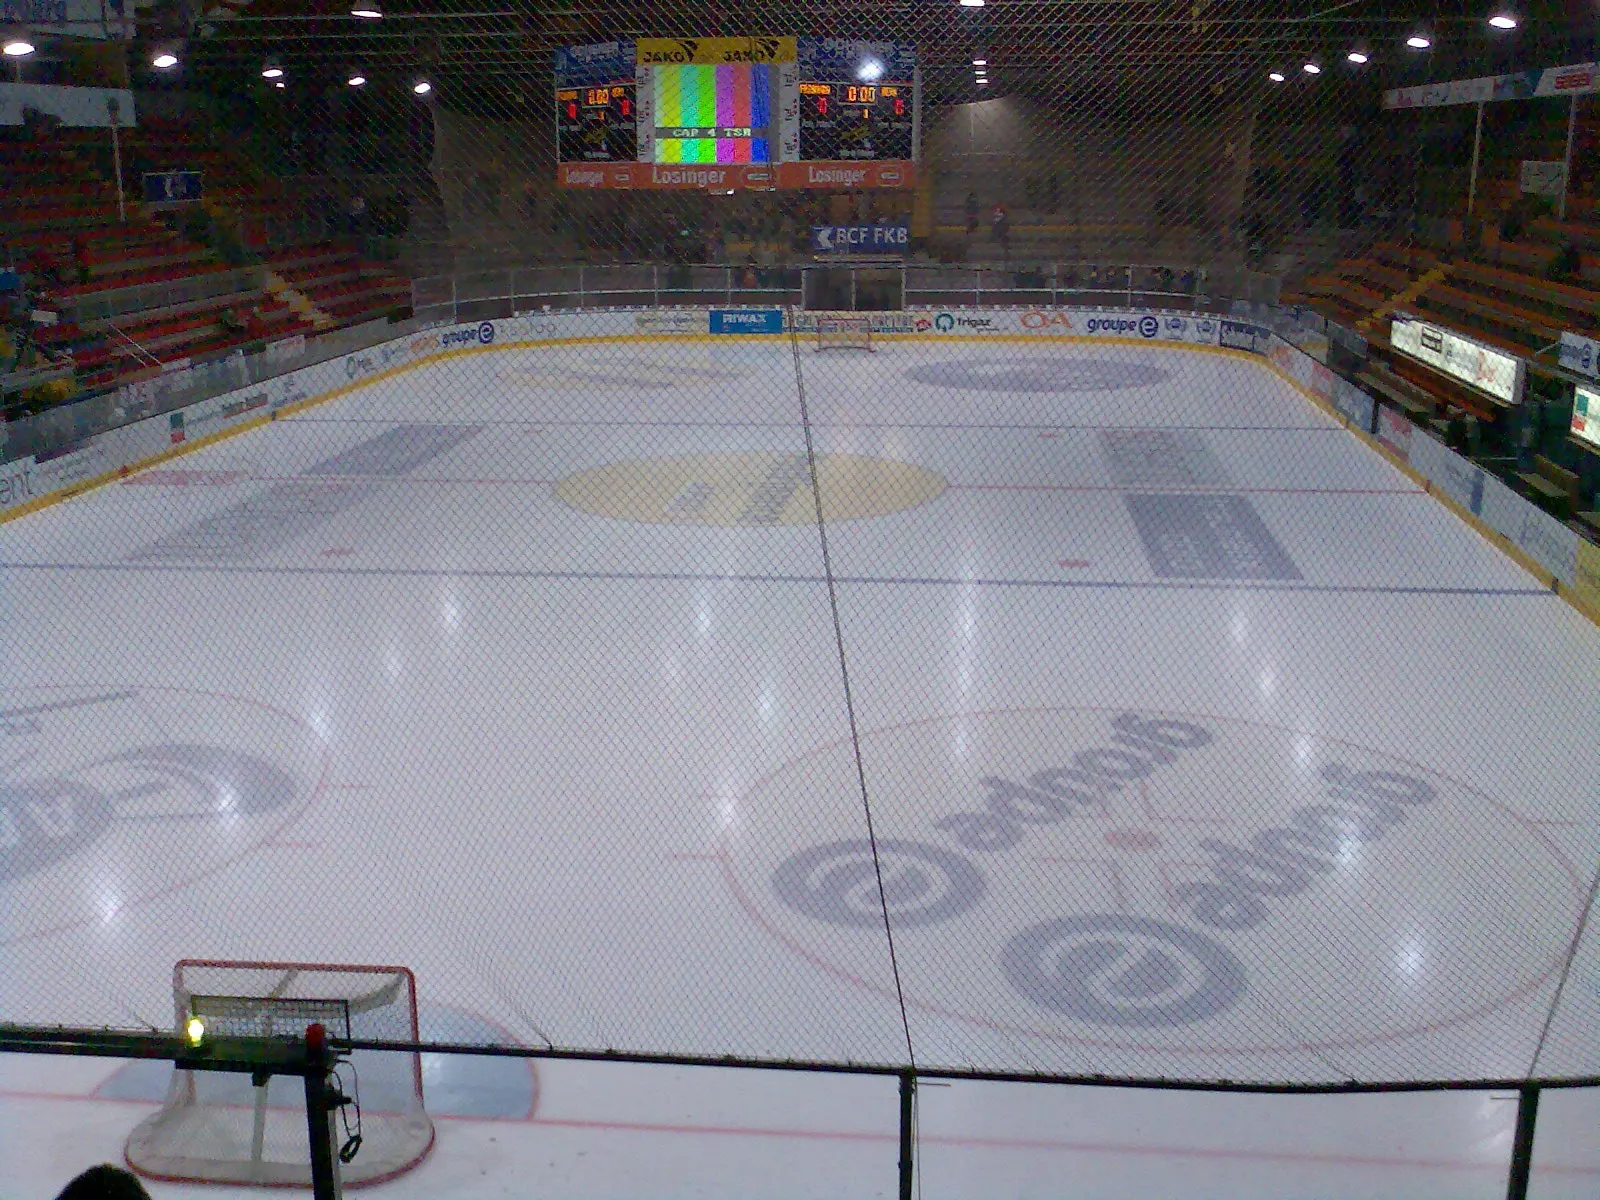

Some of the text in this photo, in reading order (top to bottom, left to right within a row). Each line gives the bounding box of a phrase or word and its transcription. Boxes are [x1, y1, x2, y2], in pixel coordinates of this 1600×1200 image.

[643, 51, 684, 62] JAKO
[672, 128, 699, 137] CAP
[707, 128, 716, 137] 4
[652, 166, 726, 187] Losinger
[808, 165, 866, 186] Losinger
[836, 227, 908, 244] BCF FKB
[722, 313, 768, 324] RIWAX
[1087, 316, 1137, 334] groupe
